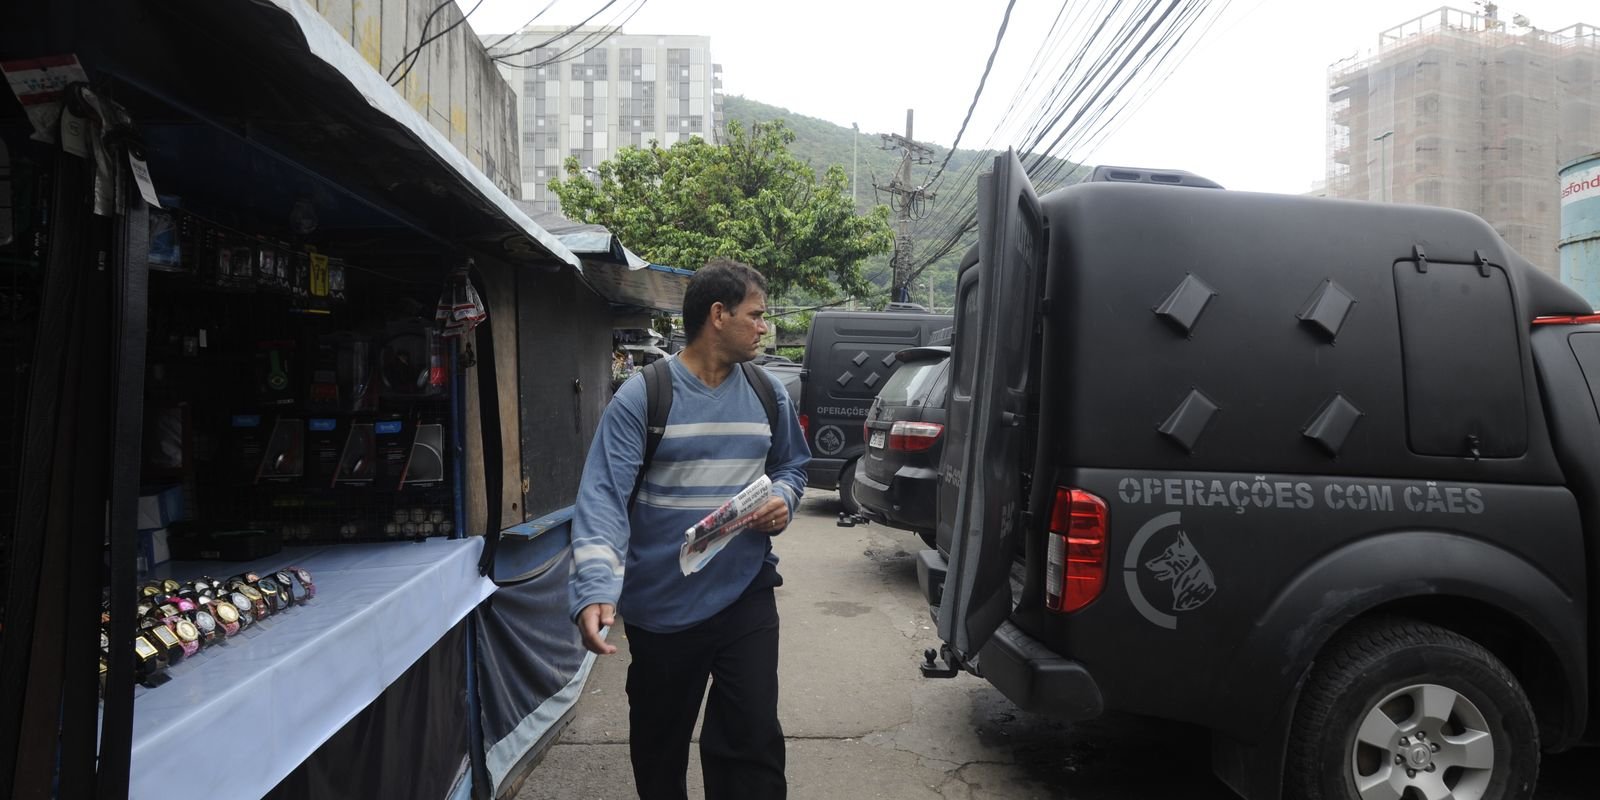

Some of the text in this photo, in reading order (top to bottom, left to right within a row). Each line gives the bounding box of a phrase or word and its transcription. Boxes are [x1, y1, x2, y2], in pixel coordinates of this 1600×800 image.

[1118, 475, 1485, 515] OPERAÇÕES COM CÃES
